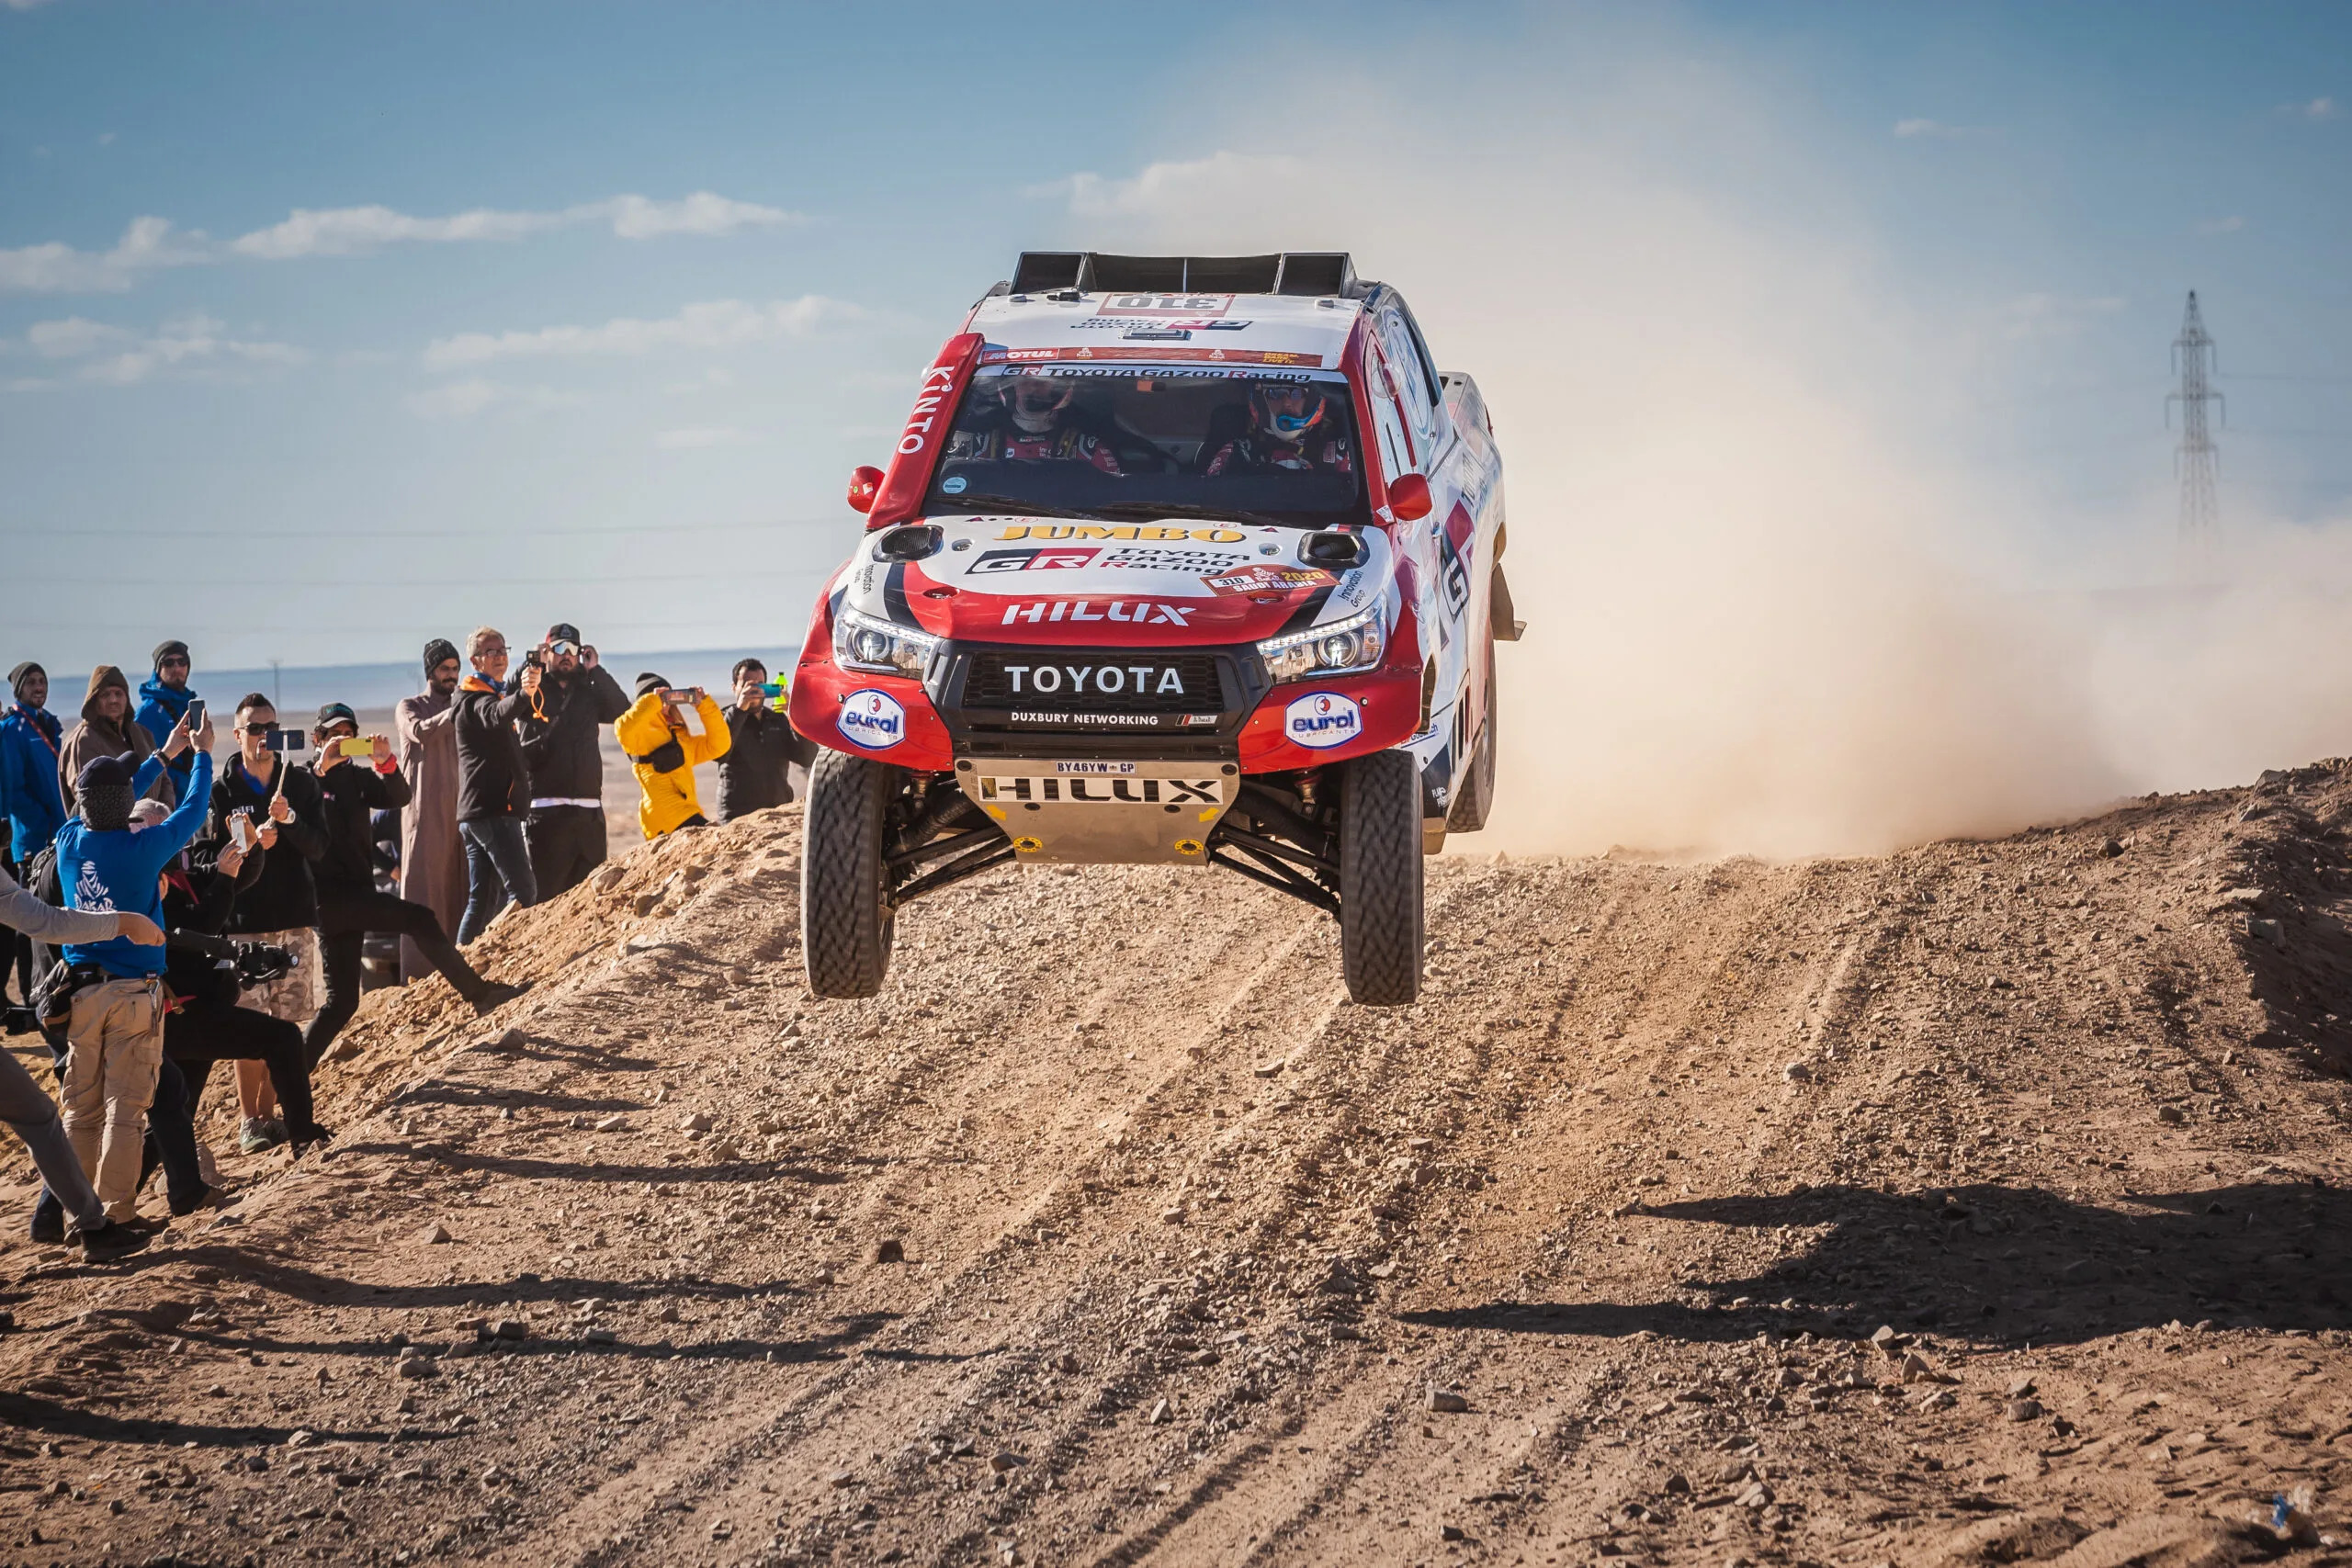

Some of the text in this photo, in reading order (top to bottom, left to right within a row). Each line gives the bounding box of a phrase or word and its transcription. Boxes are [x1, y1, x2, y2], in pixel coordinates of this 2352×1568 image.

[1117, 297, 1218, 310] 310
[989, 350, 1054, 360] MOTUL
[1002, 367, 1041, 376] GR
[1046, 368, 1312, 384] TOYOTA GAZOO Racing
[993, 525, 1248, 543] JUMBO
[1114, 547, 1250, 560] TOYOTA
[969, 552, 1094, 573] GR
[1106, 554, 1234, 568] GAZOO
[1099, 561, 1225, 576] Racing
[1218, 577, 1244, 586] 310
[1281, 571, 1326, 581] 2020
[1233, 580, 1317, 592] SAUDI ARABIA
[1001, 601, 1197, 626] HILUX
[1004, 666, 1184, 694] TOYOTA
[845, 711, 899, 734] eurol
[1011, 712, 1159, 726] DUXBURY NETWORKING
[1292, 709, 1355, 733] eurol
[1292, 730, 1356, 739] LUBRICANTS
[1120, 762, 1135, 773] GP
[980, 777, 1221, 804] HILUX
[74, 893, 117, 912] DAKAR
